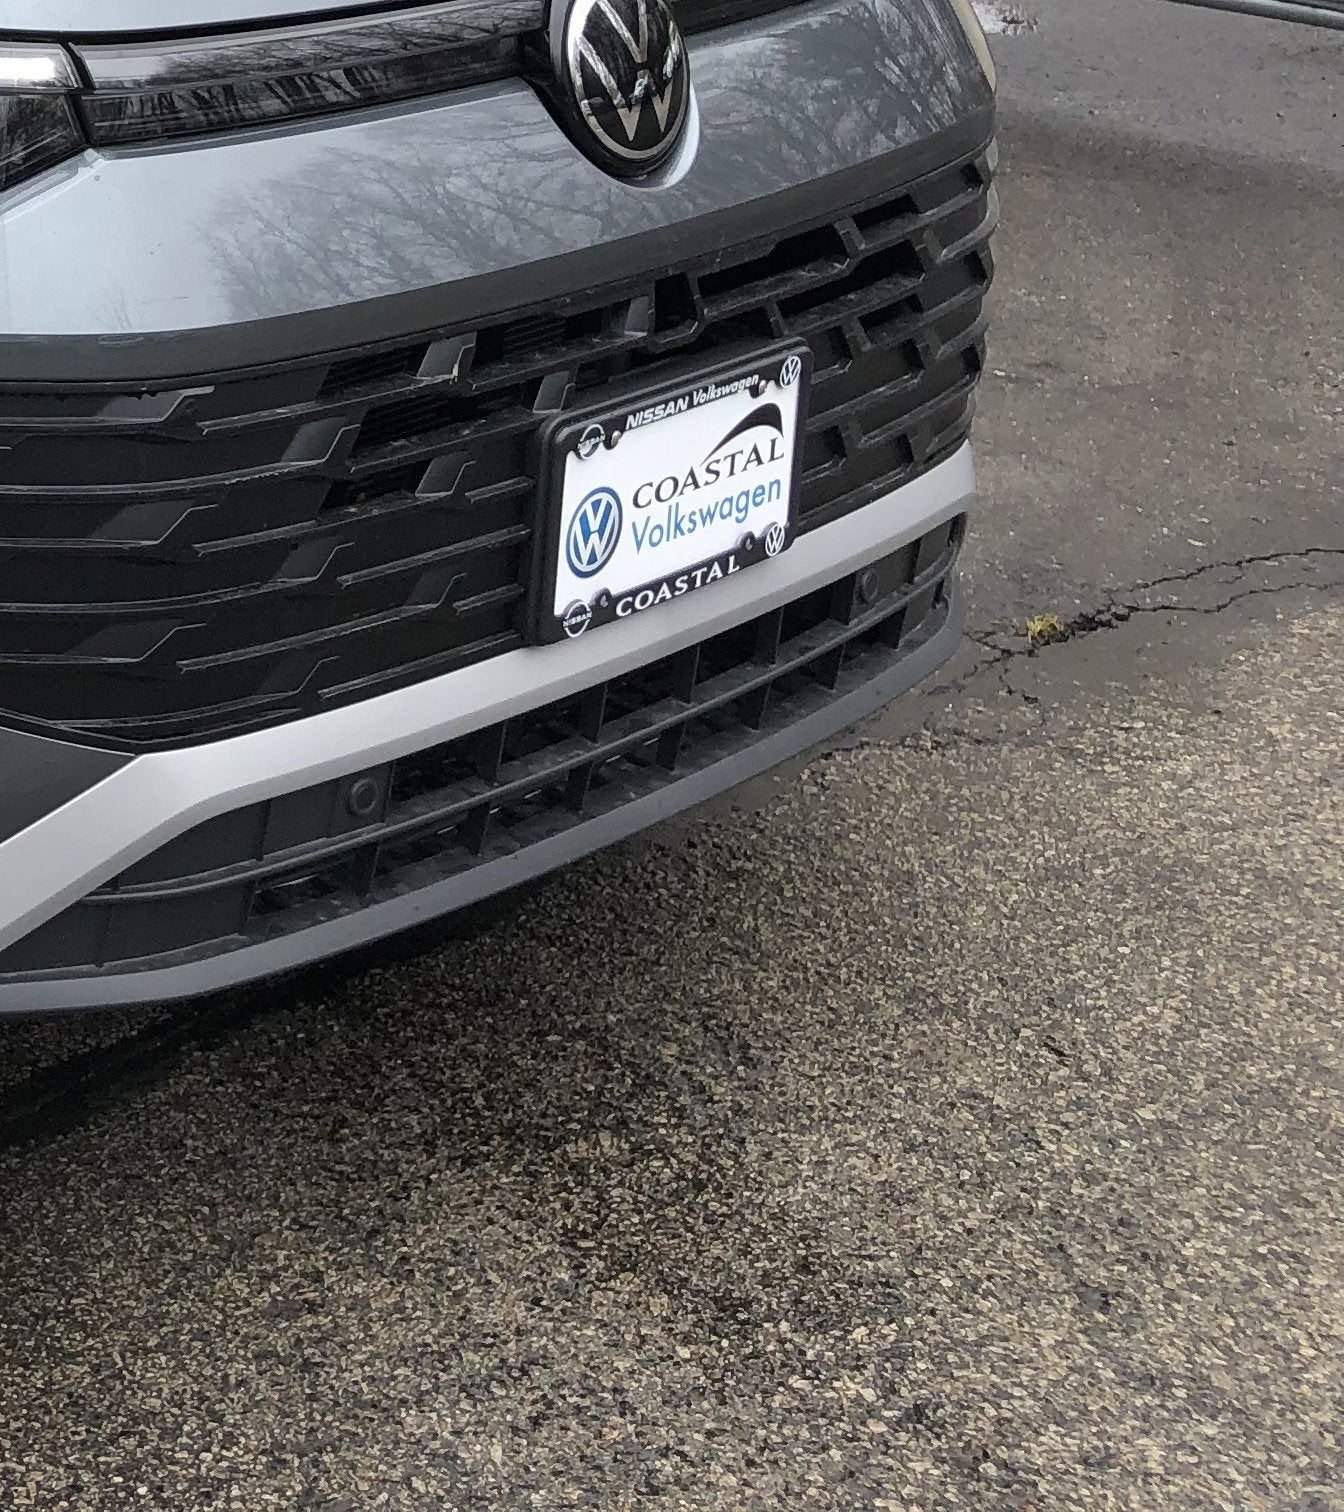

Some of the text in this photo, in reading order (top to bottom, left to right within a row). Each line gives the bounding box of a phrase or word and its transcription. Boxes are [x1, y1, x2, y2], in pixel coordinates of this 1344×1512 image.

[625, 374, 760, 430] NISSAN Volkswagen
[632, 437, 785, 509] COASTAL
[631, 478, 782, 555] Volkswagen
[615, 555, 741, 618] COASTAL
